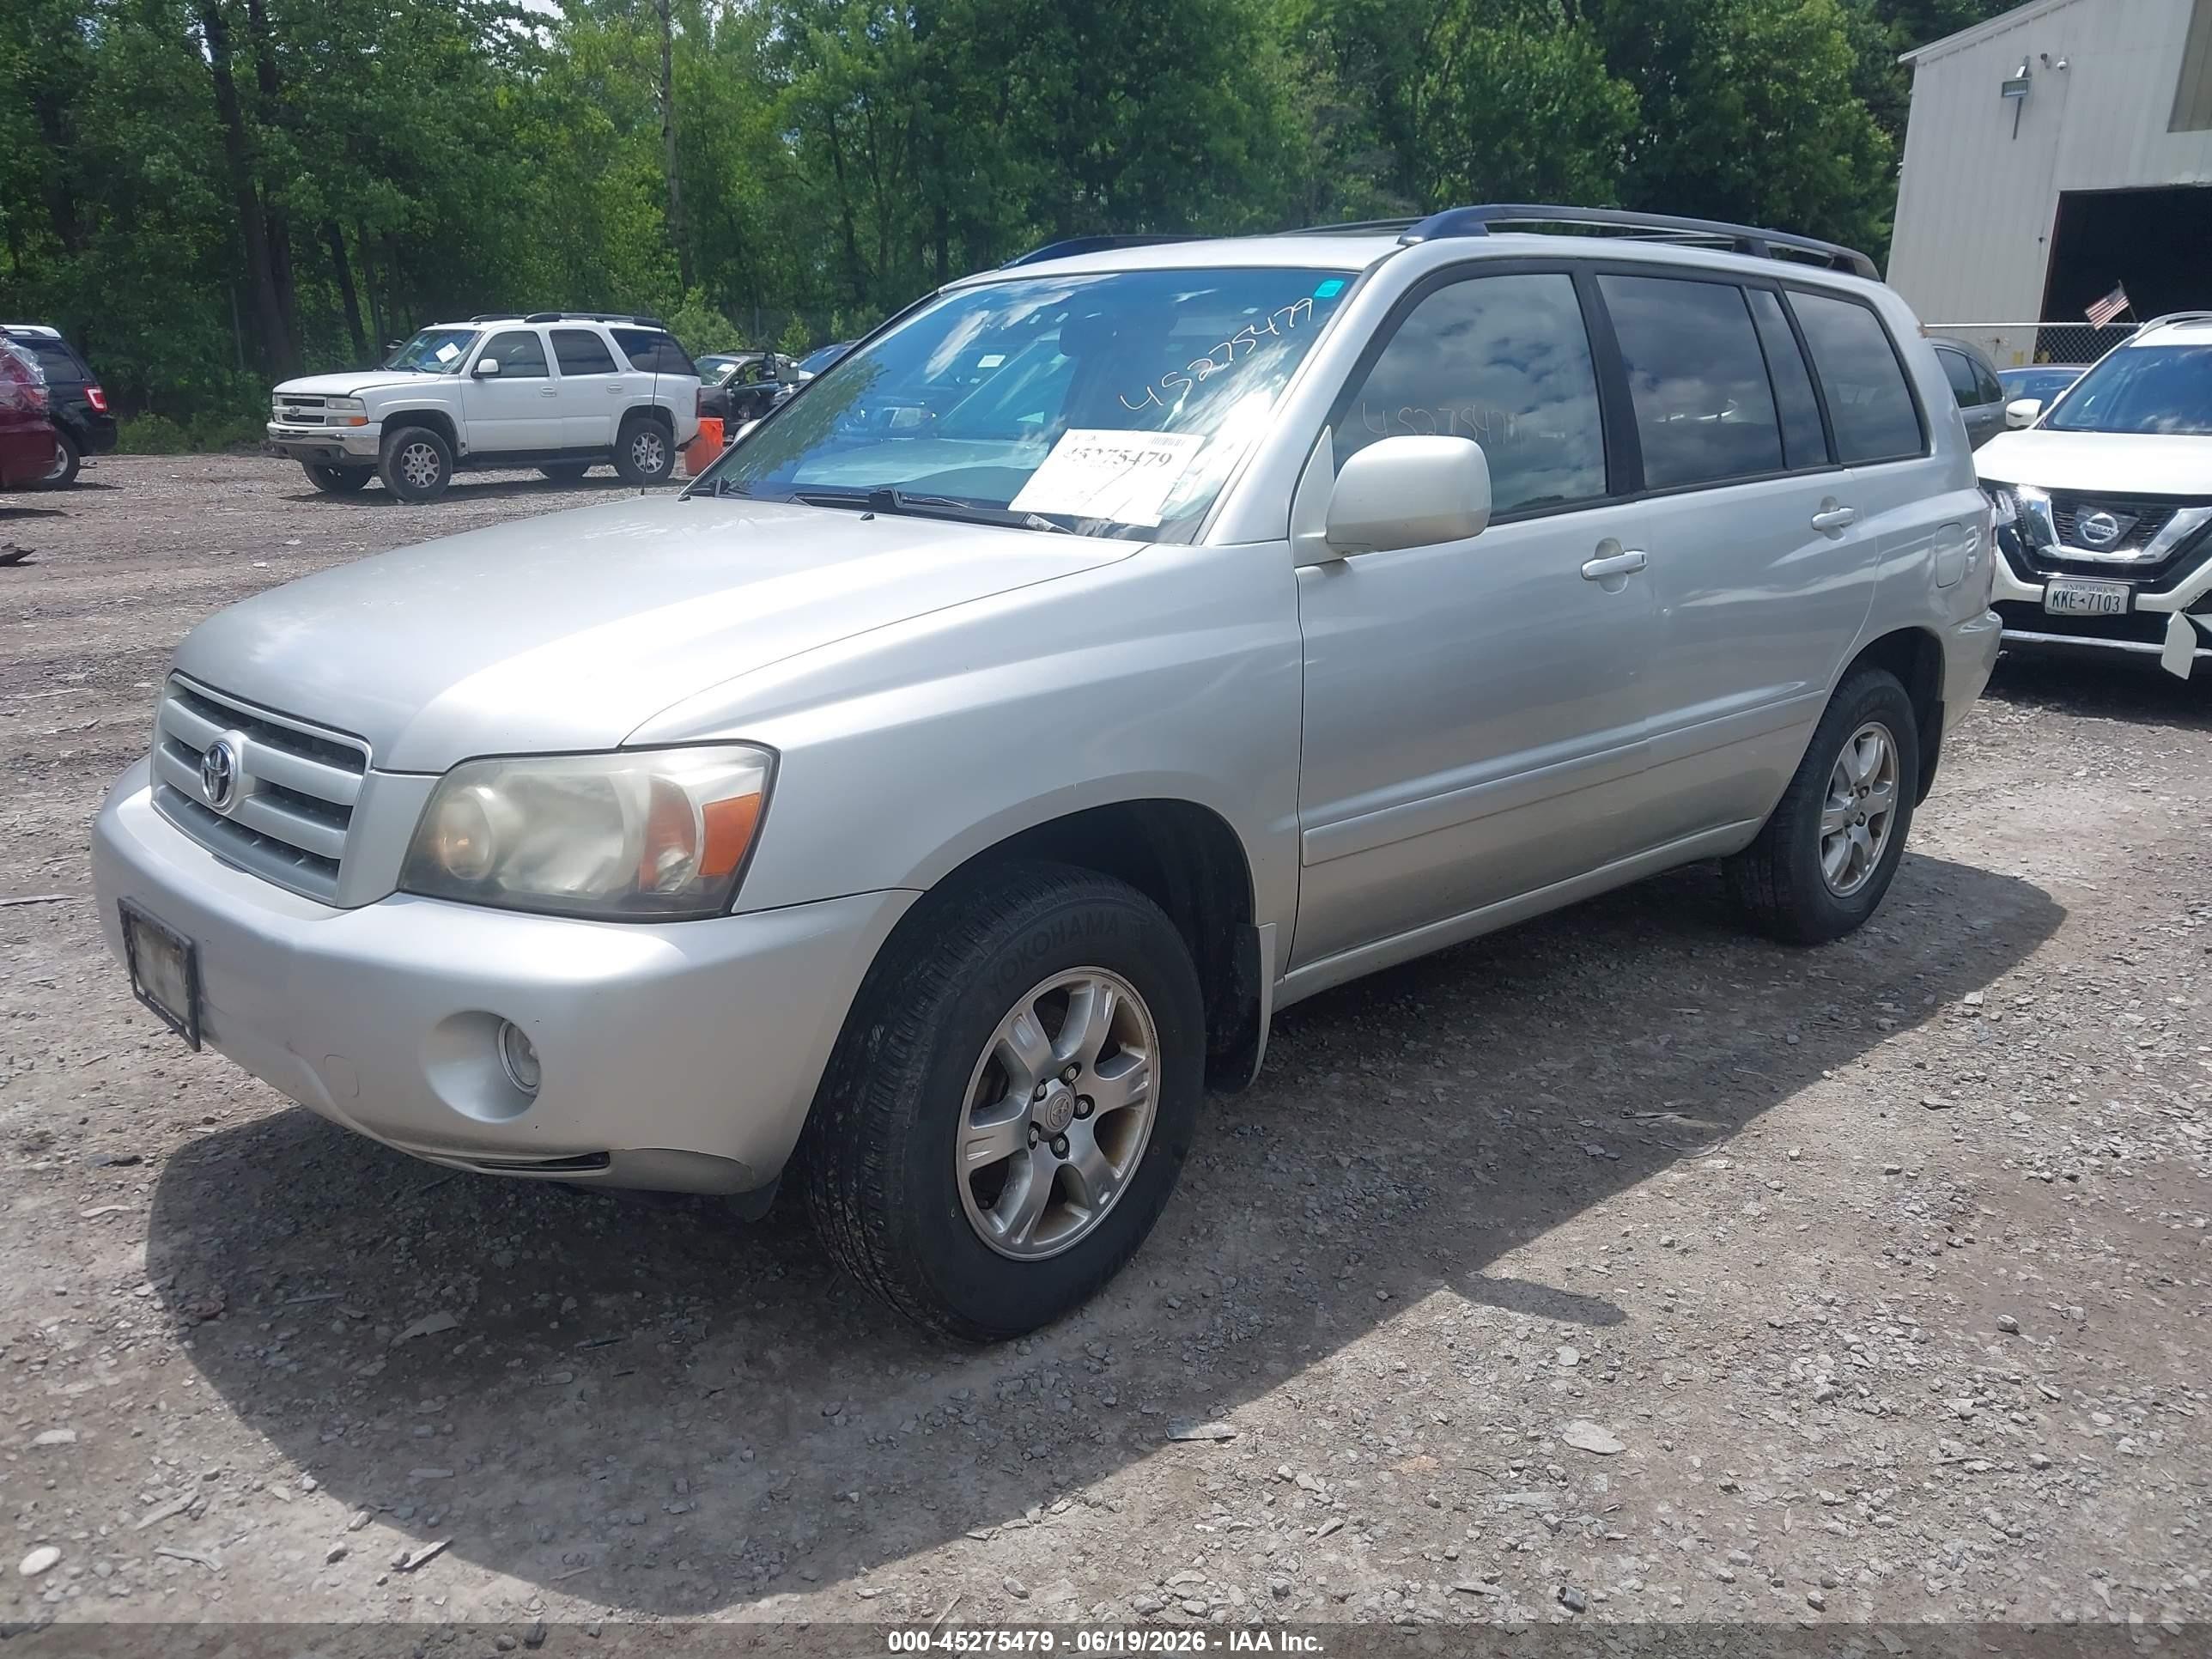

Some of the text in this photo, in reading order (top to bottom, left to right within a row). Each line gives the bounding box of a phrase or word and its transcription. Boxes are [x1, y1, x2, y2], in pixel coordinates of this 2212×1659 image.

[1120, 297, 1314, 411] 45275479
[2082, 523, 2115, 535] NISSAN
[988, 911, 1120, 996] YOKOHAMA
